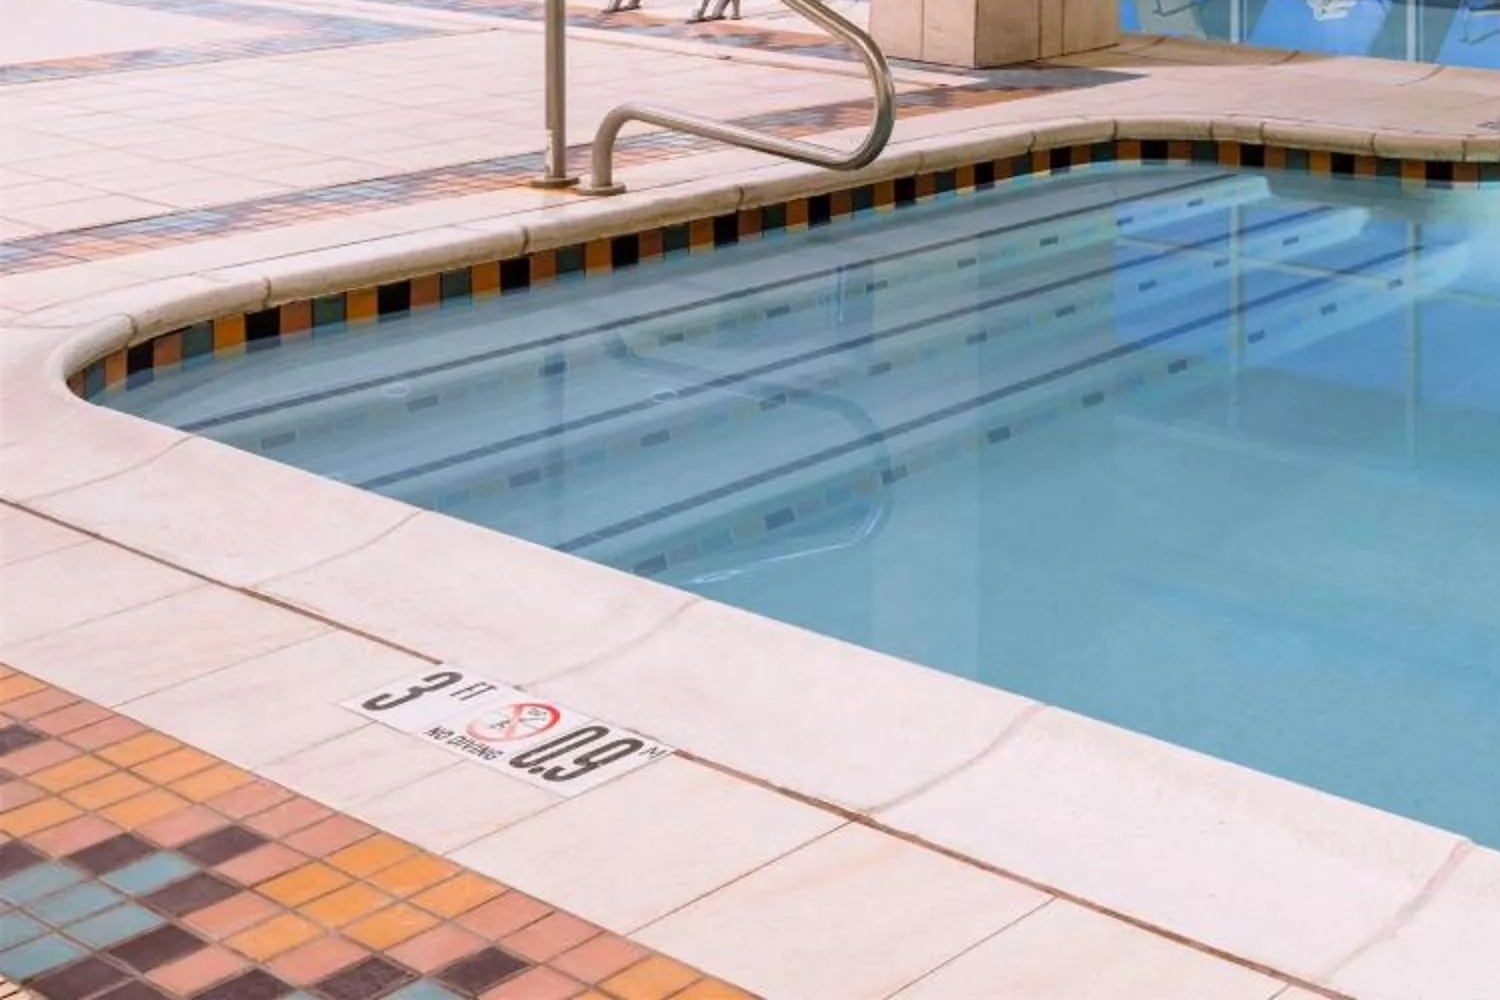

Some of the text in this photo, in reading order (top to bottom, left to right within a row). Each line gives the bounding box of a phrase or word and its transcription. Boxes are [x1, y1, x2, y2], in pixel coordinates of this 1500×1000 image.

[361, 671, 497, 711] 3 FT
[424, 726, 505, 760] NO DIVING
